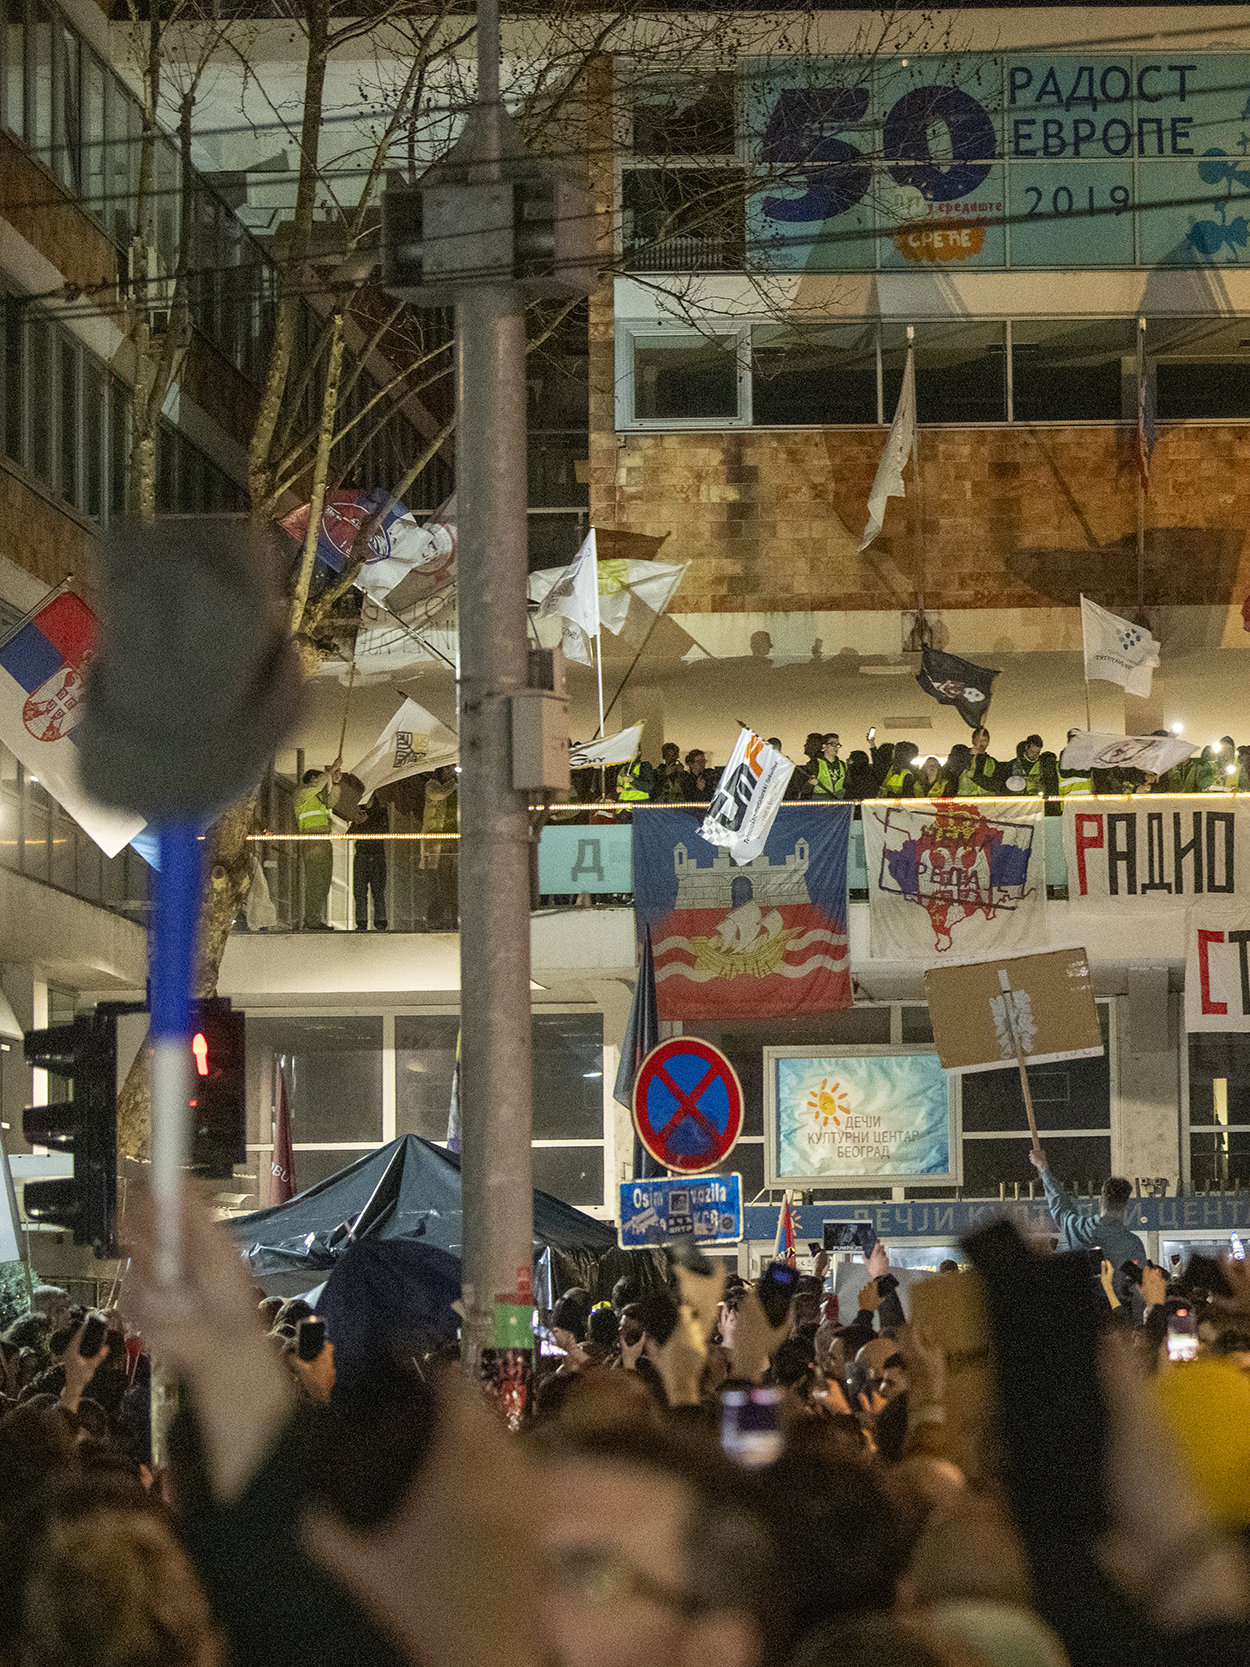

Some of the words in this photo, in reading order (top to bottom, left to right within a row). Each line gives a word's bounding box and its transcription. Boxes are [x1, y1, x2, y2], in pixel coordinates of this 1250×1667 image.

[1010, 65, 1196, 112] РАДОСТ
[761, 85, 996, 223] 50
[1013, 117, 1194, 156] ЕВРОПЕ
[1025, 186, 1131, 217] 2019
[1075, 811, 1235, 896] РАДИО
[807, 1131, 869, 1144] КУЛТУРНИ
[874, 1129, 920, 1144] ЦЕНТАР
[845, 1116, 881, 1130] ДЕЧЈИ
[837, 1146, 890, 1158] БЕОГРАД
